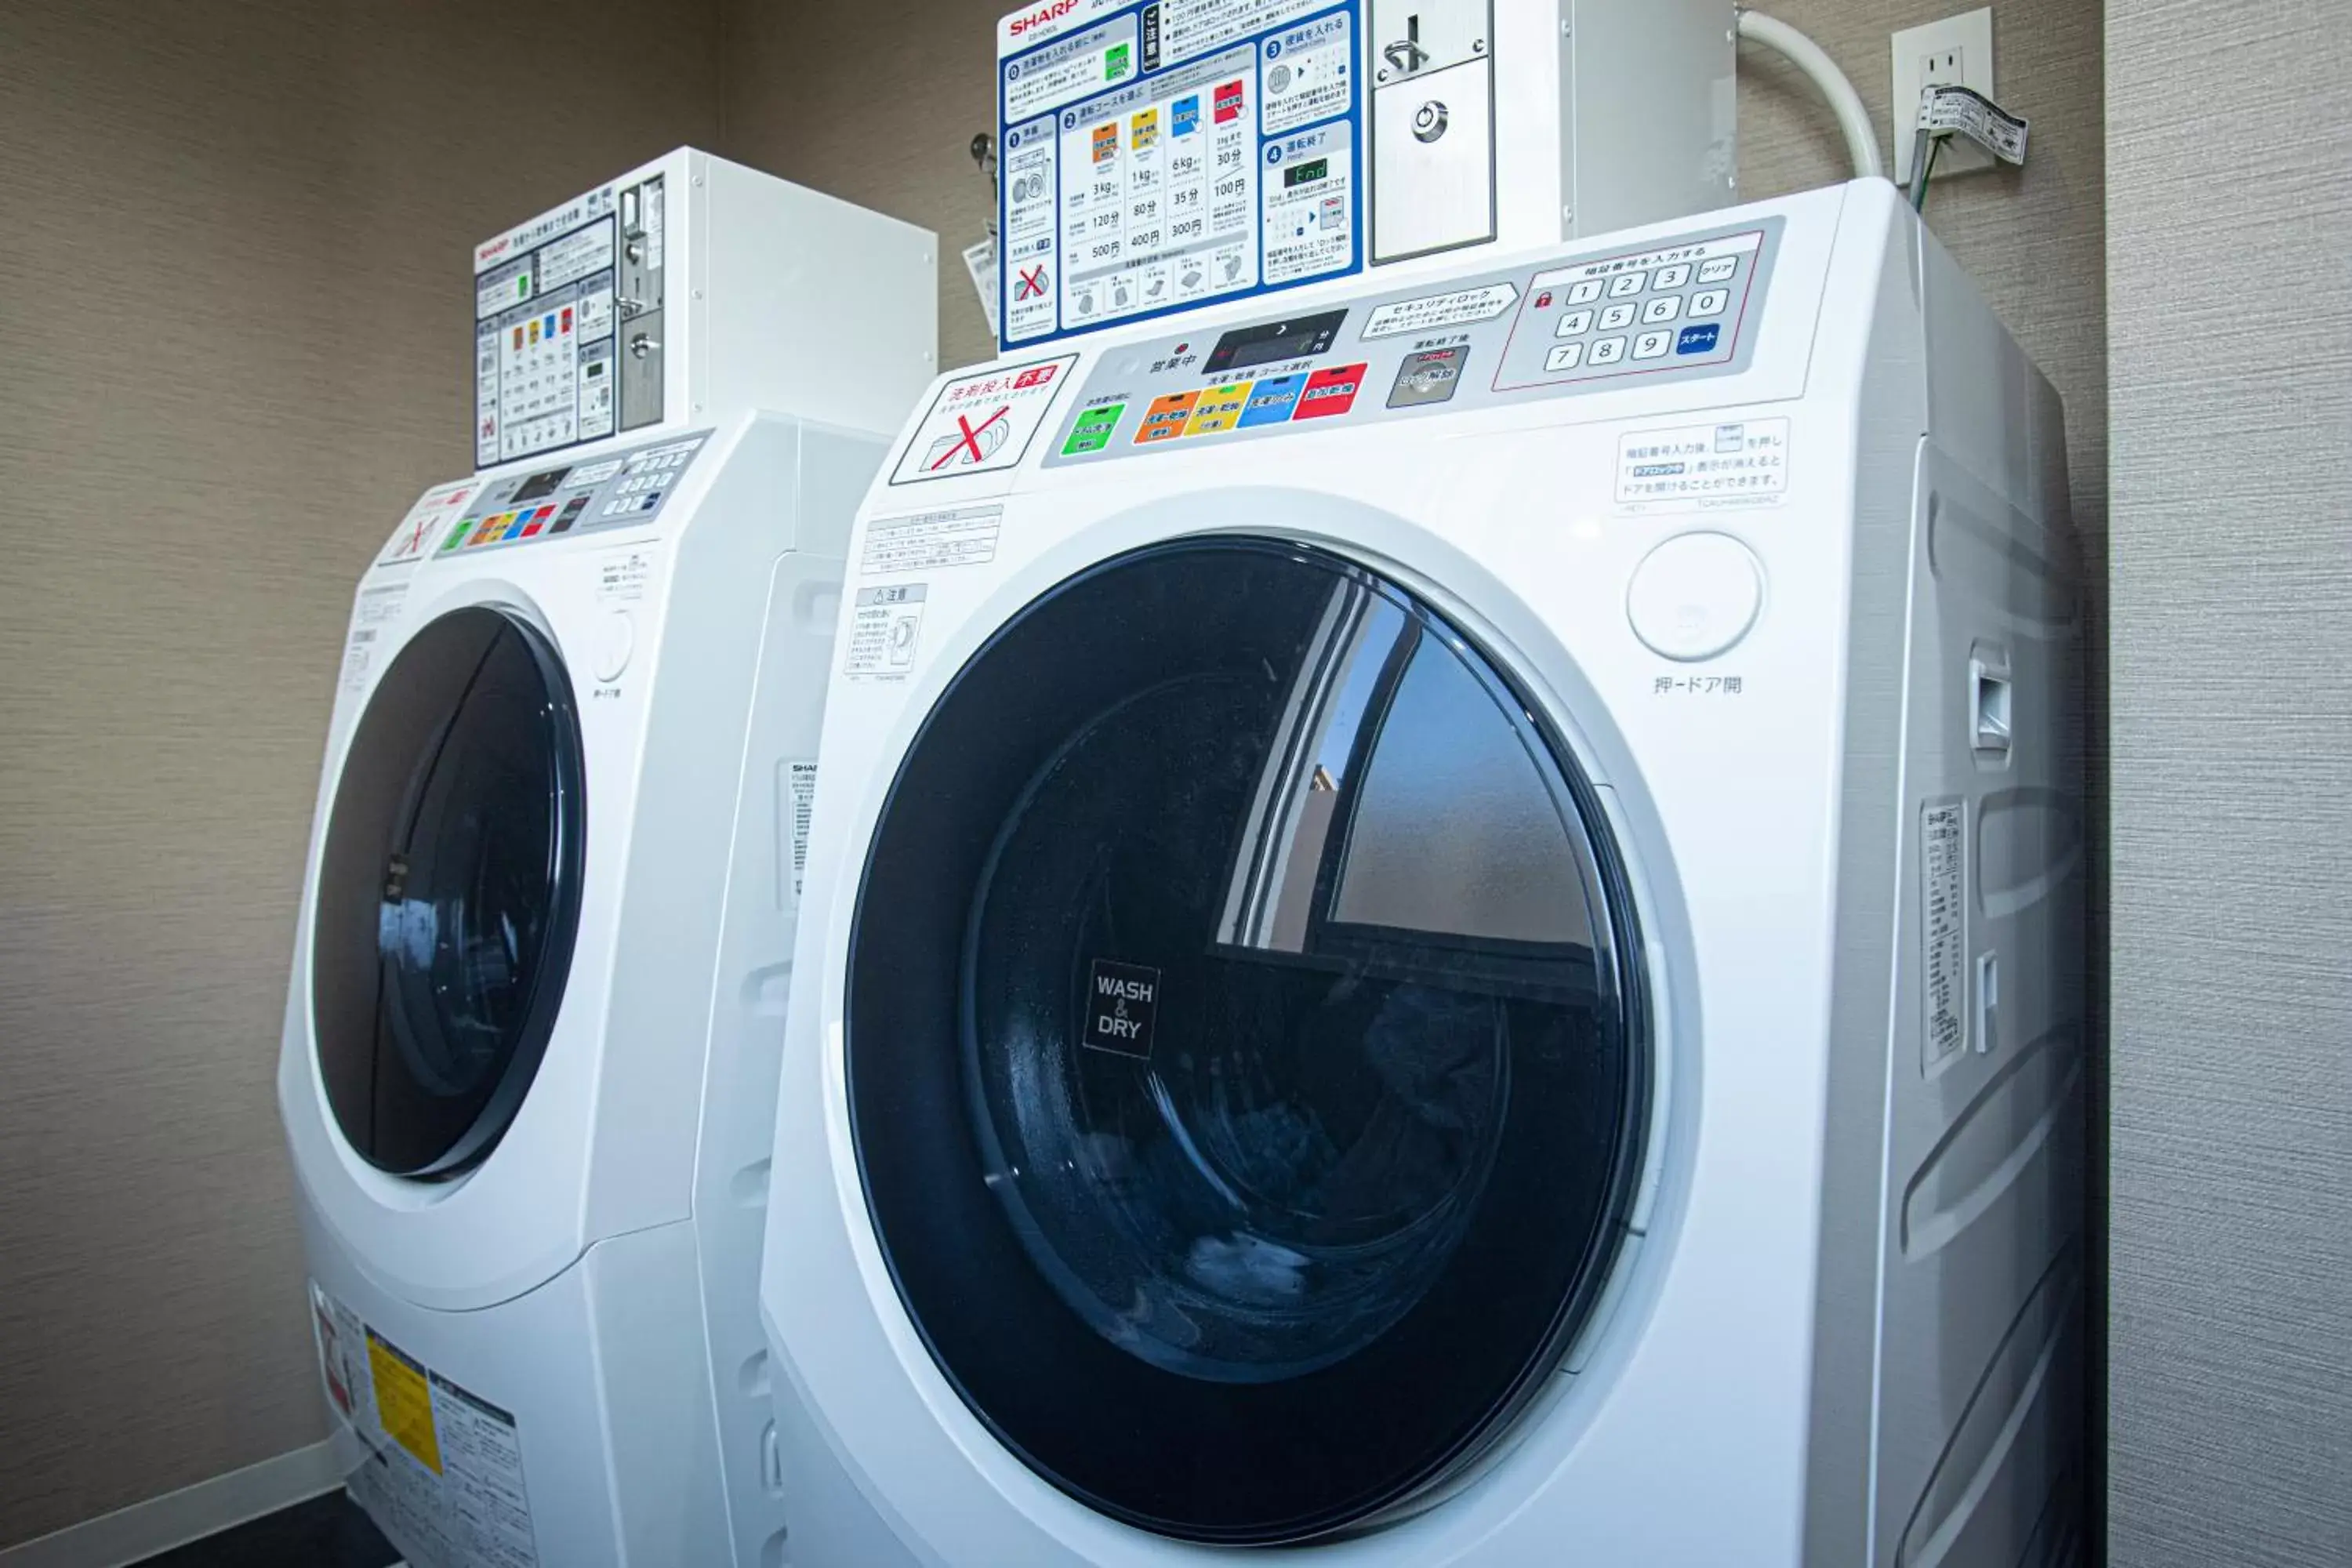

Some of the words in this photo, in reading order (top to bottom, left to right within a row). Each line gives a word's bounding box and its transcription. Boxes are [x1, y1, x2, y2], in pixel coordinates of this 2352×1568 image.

[1010, 0, 1078, 36] SHARP
[1286, 18, 1343, 45] 硬貨を入れる
[1287, 132, 1327, 153] 運転終了
[1217, 148, 1242, 165] 30分
[1296, 162, 1326, 183] End
[1174, 188, 1199, 205] 35分
[1214, 178, 1247, 197] 100円
[1134, 201, 1156, 216] 80分
[1094, 211, 1120, 229] 120分
[1172, 219, 1202, 238] 300円
[1131, 230, 1160, 248] 400円
[1092, 241, 1120, 258] 500円
[1584, 247, 1707, 276] 暗証番号を入力する
[1702, 263, 1734, 277] クリア
[1581, 285, 1588, 299] 1
[1621, 278, 1633, 291] 2
[1665, 270, 1676, 285] 3
[1394, 290, 1490, 314] セキュリティロック
[1567, 315, 1579, 329] 4
[1610, 308, 1623, 323] 5
[1654, 302, 1667, 316] 6
[1700, 296, 1714, 310] 0
[1414, 333, 1469, 350] 運転終了後
[1682, 332, 1716, 347] スタート
[1558, 350, 1571, 364] 7
[1599, 343, 1612, 358] 8
[1645, 336, 1657, 351] 9
[1149, 354, 1197, 374] 営業中
[949, 377, 1011, 401] 洗剤投入
[1098, 976, 1153, 1003] WASH
[1115, 998, 1129, 1018] &
[1098, 1015, 1142, 1040] DRY
